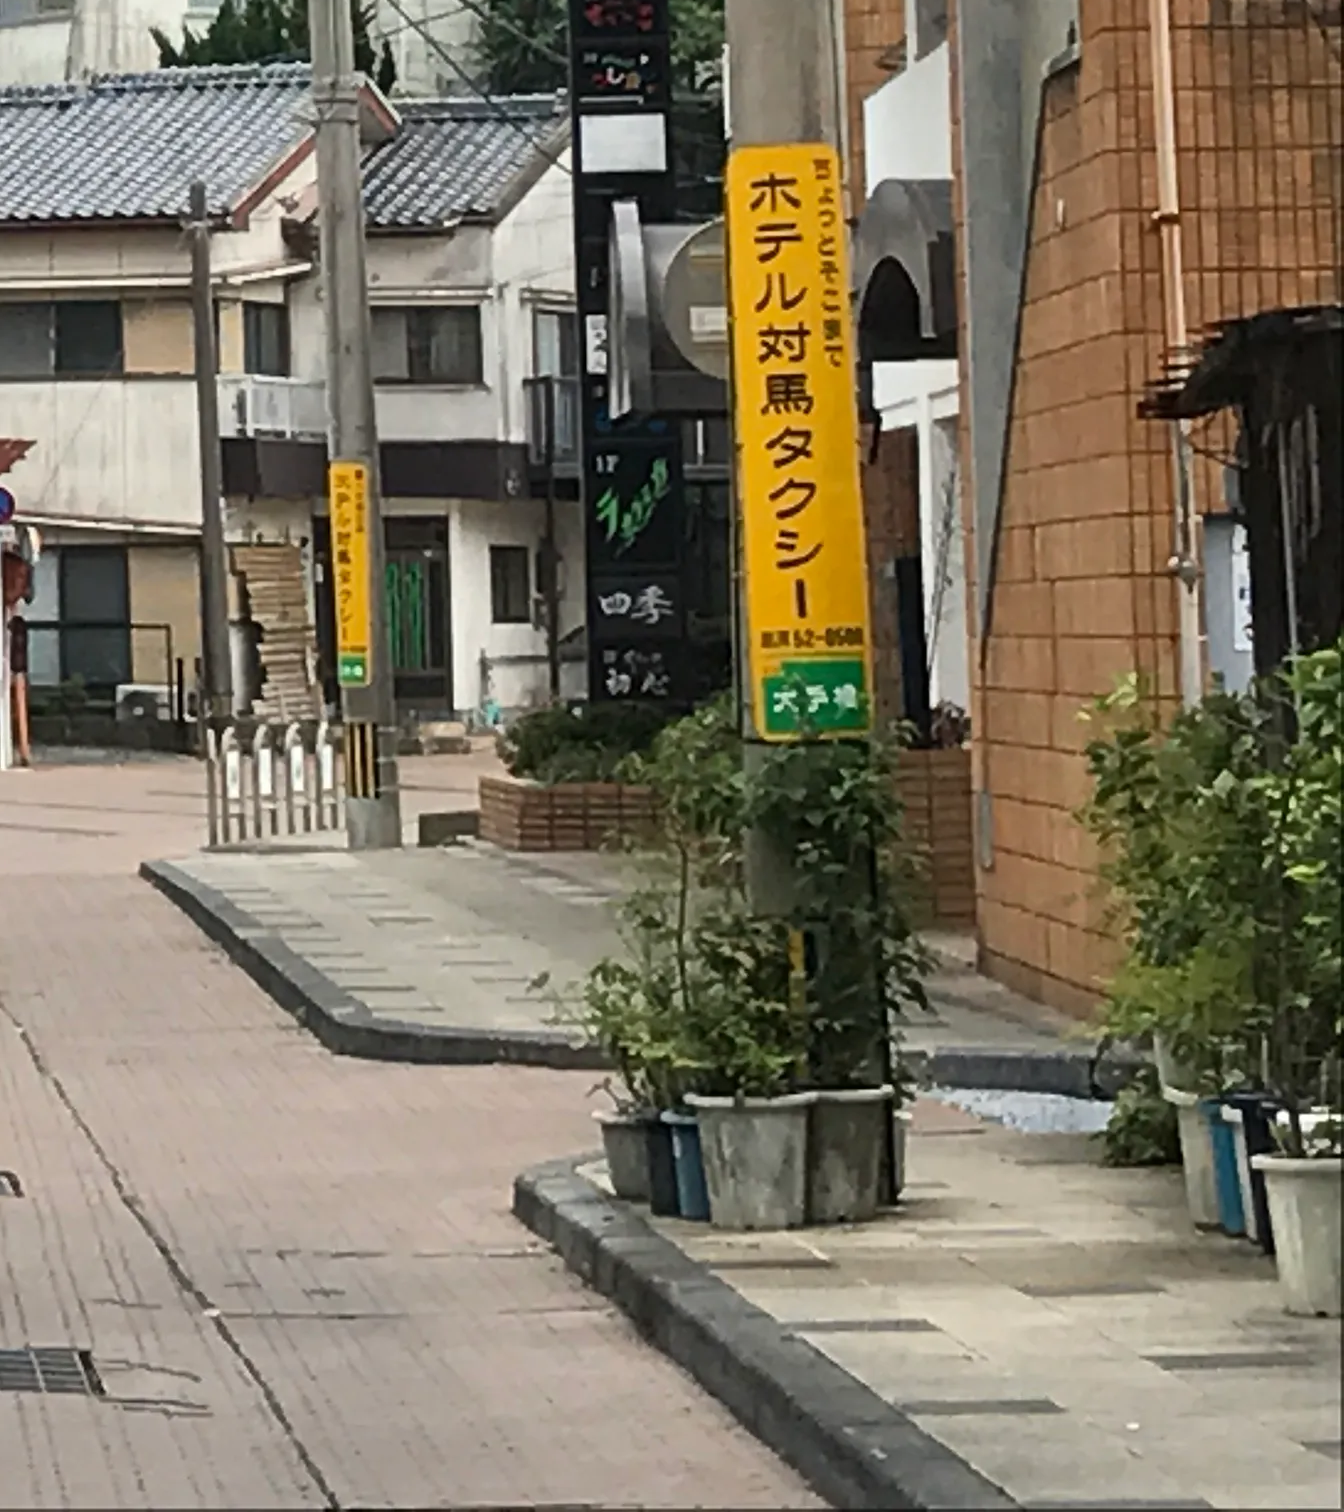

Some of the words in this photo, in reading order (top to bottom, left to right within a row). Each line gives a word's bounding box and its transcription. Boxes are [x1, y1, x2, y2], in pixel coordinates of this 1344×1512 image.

[750, 173, 824, 619] ホテル対馬タクシー
[597, 585, 674, 624] 四季
